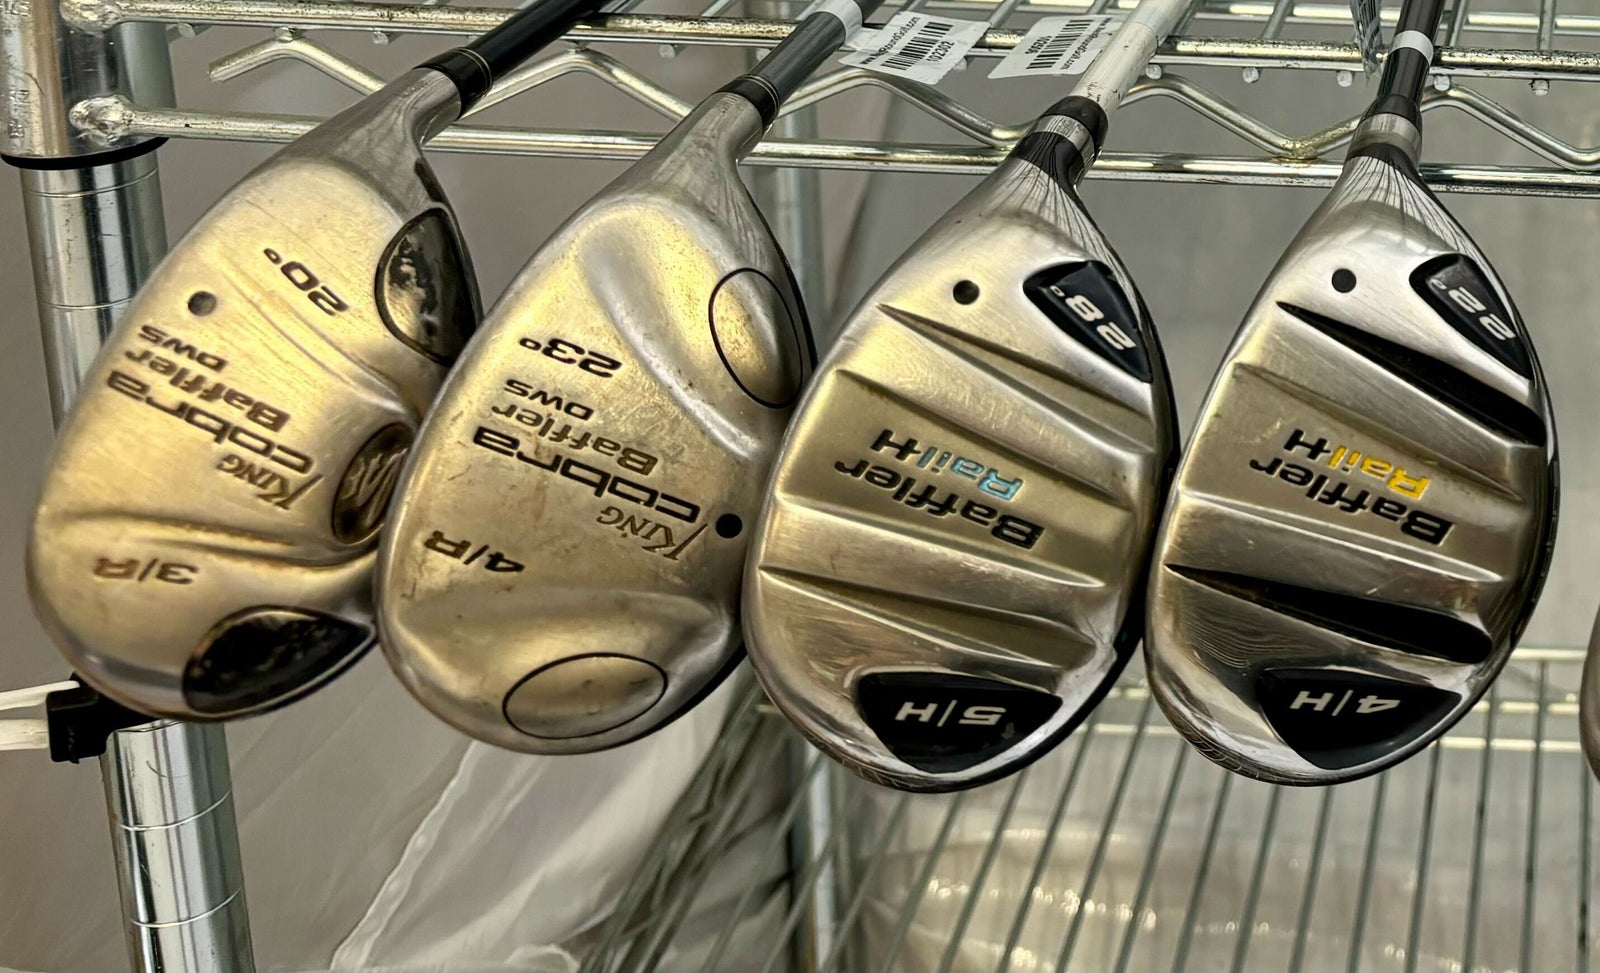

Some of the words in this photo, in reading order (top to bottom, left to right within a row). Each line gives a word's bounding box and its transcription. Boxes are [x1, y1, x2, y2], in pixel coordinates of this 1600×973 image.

[139, 324, 229, 373] DWS
[127, 351, 290, 433] Baffler
[503, 379, 594, 421] DWS
[492, 402, 660, 476] Baffler
[834, 458, 1045, 550] Baffler
[1250, 458, 1456, 545] Baffler
[93, 558, 199, 586] 3/R
[423, 530, 525, 574] 4/R
